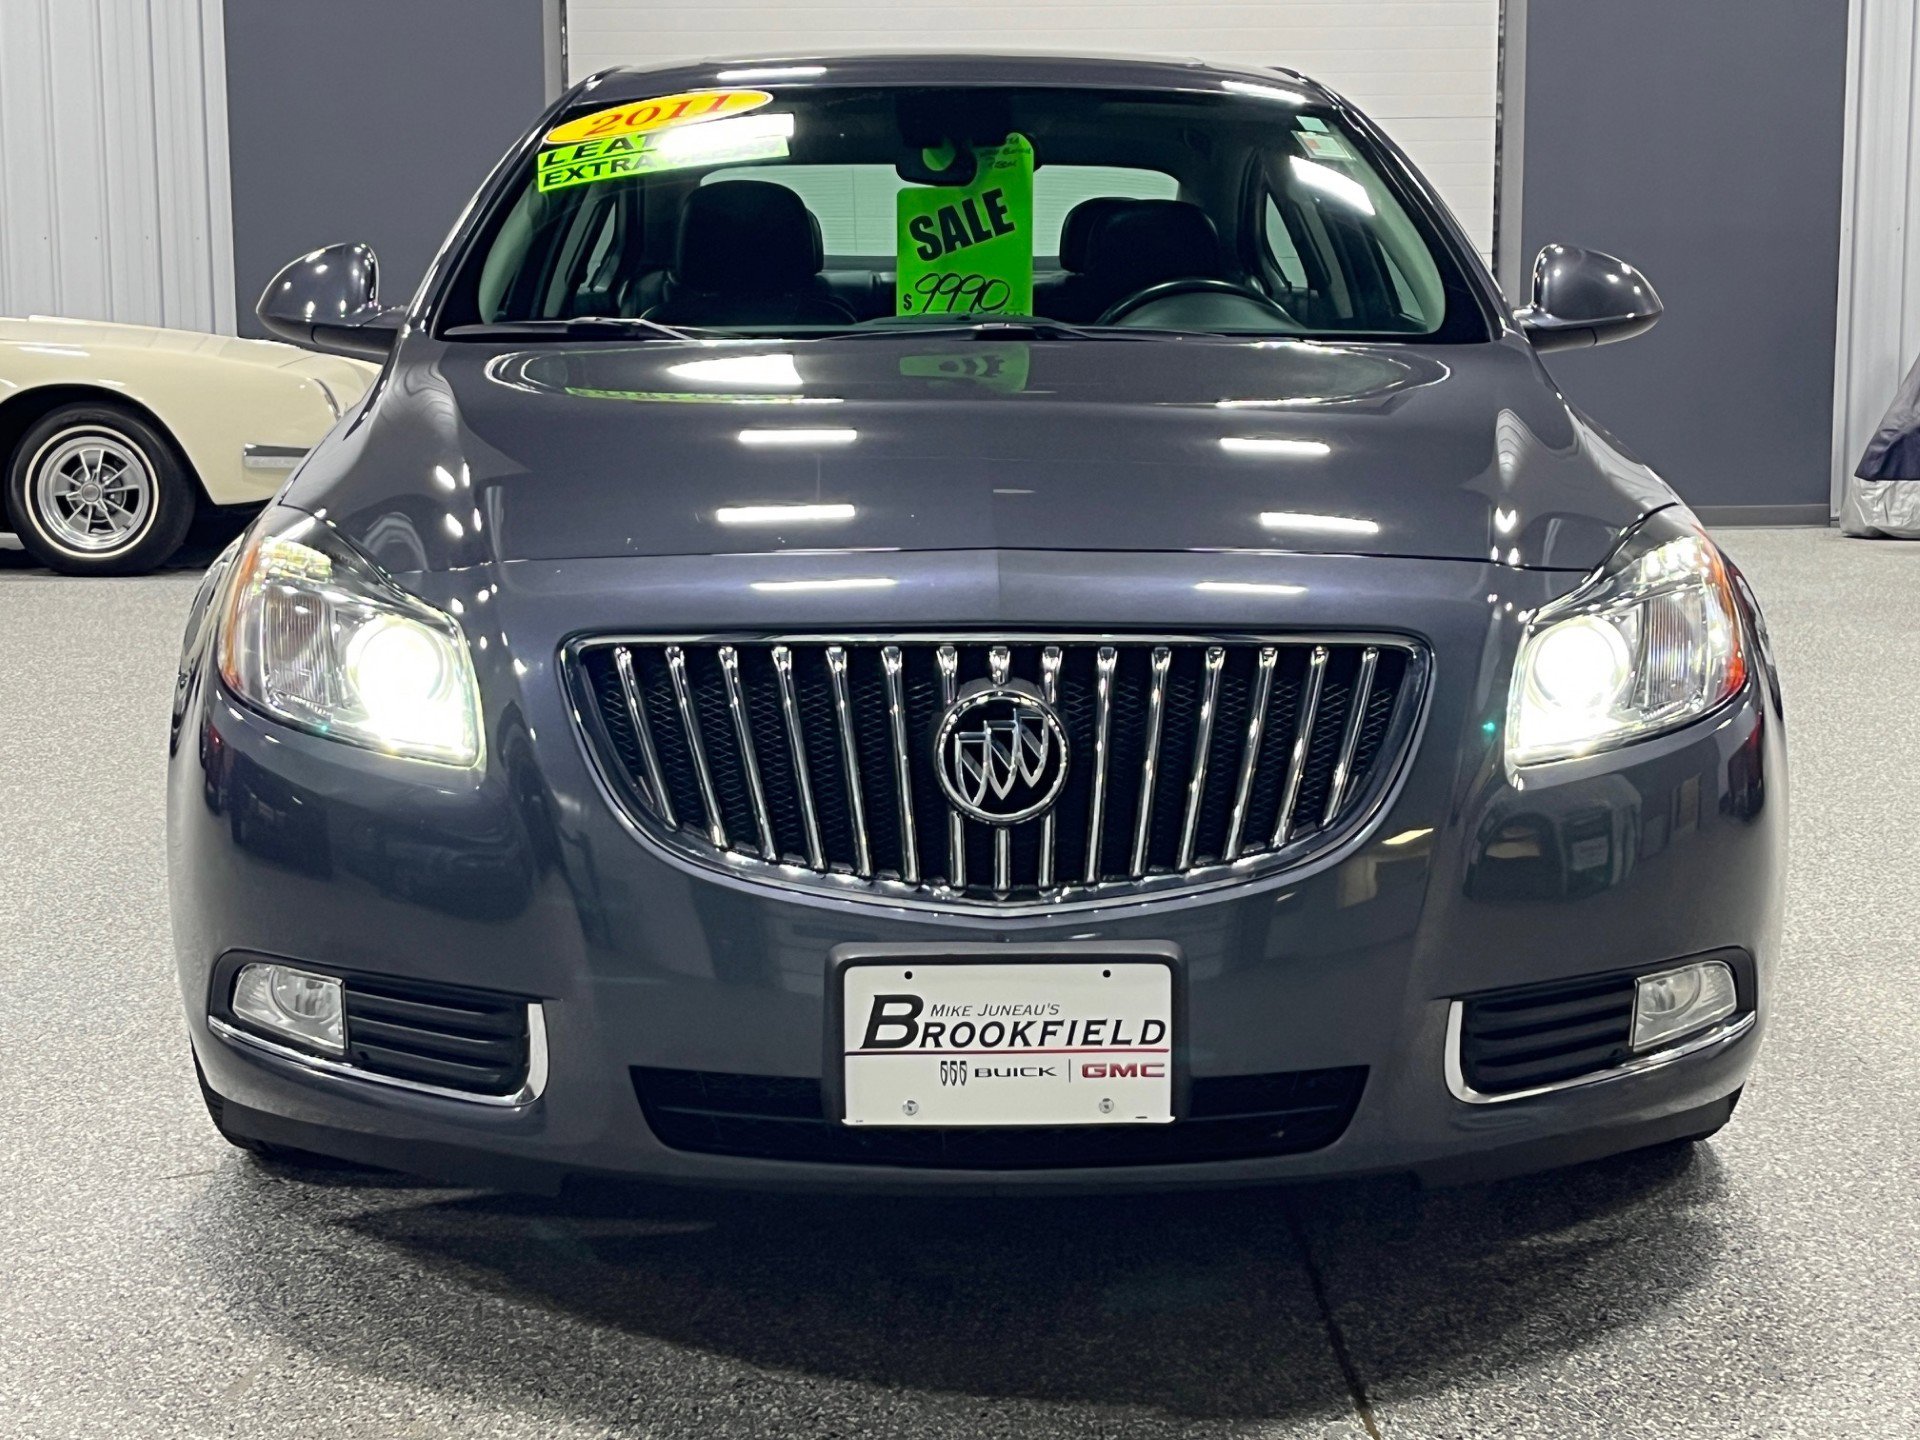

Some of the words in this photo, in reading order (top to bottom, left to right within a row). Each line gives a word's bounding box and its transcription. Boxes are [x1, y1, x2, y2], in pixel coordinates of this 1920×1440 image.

[587, 93, 732, 136] 2011
[542, 133, 658, 168] LEAT
[543, 154, 658, 187] EXTRA
[908, 188, 1016, 262] SALE
[859, 993, 1168, 1050] BROOKFIELD
[930, 1003, 973, 1018] MIKE
[977, 1002, 1061, 1018] JUNEAU'S
[974, 1065, 1058, 1079] BUICK
[1081, 1062, 1166, 1079] GMC
